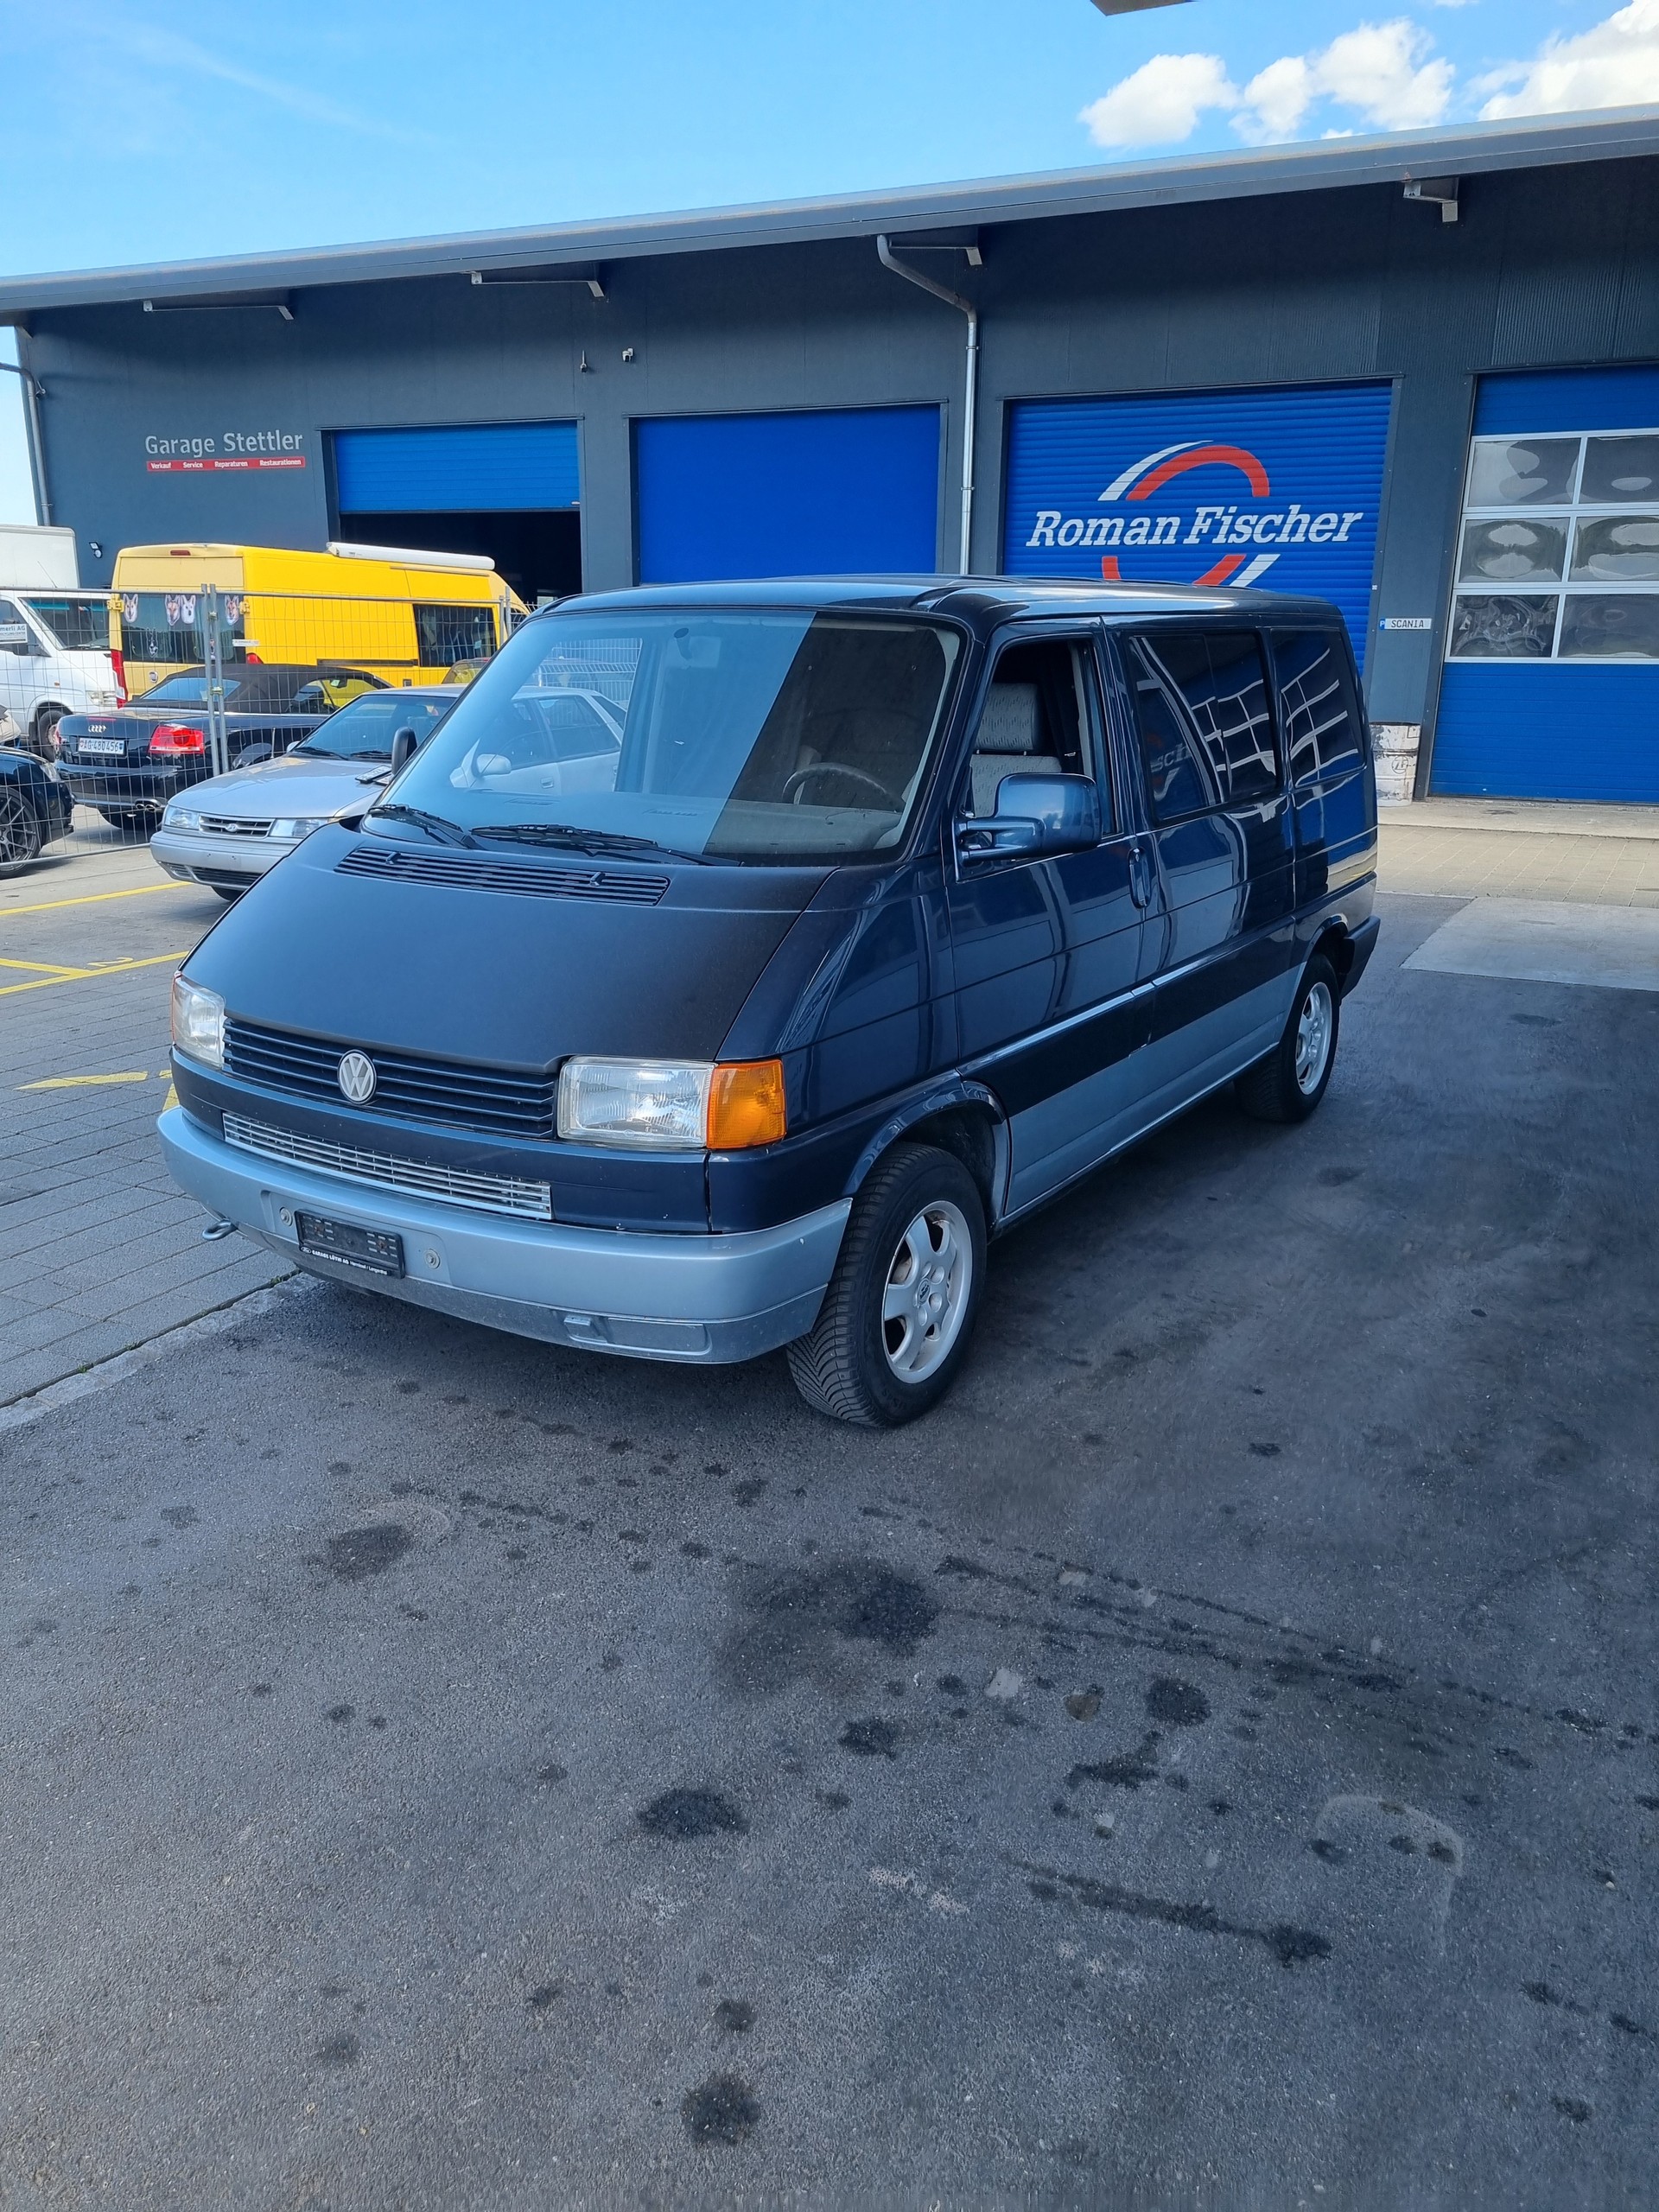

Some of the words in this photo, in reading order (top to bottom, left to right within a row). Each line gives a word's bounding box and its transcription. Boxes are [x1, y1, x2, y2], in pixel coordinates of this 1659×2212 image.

[145, 435, 215, 458] Garage
[223, 429, 303, 452] Stettler
[214, 459, 249, 467] Reparaturen
[259, 457, 302, 466] Restaurationen
[1026, 511, 1180, 546] Roman
[1182, 505, 1363, 545] Fischer
[1391, 620, 1424, 628] SCANIA
